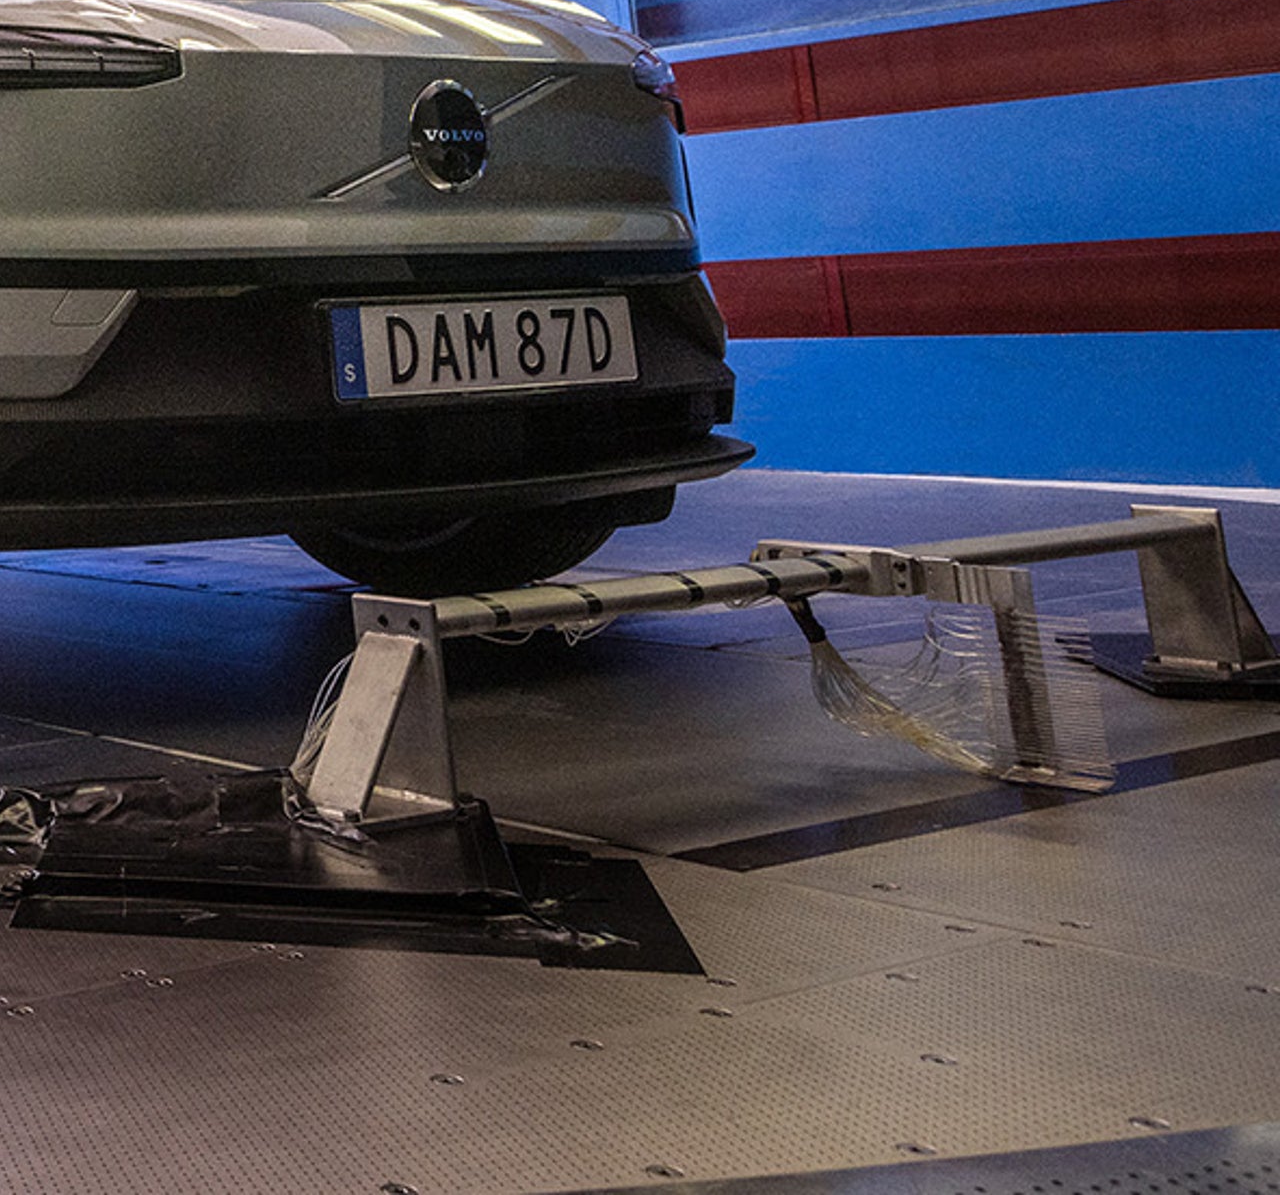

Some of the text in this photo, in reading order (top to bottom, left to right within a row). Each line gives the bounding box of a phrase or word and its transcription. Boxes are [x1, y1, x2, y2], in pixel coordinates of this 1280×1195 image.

[423, 129, 484, 142] VOLVO
[386, 307, 612, 384] DAM 87D
[344, 363, 357, 383] S
